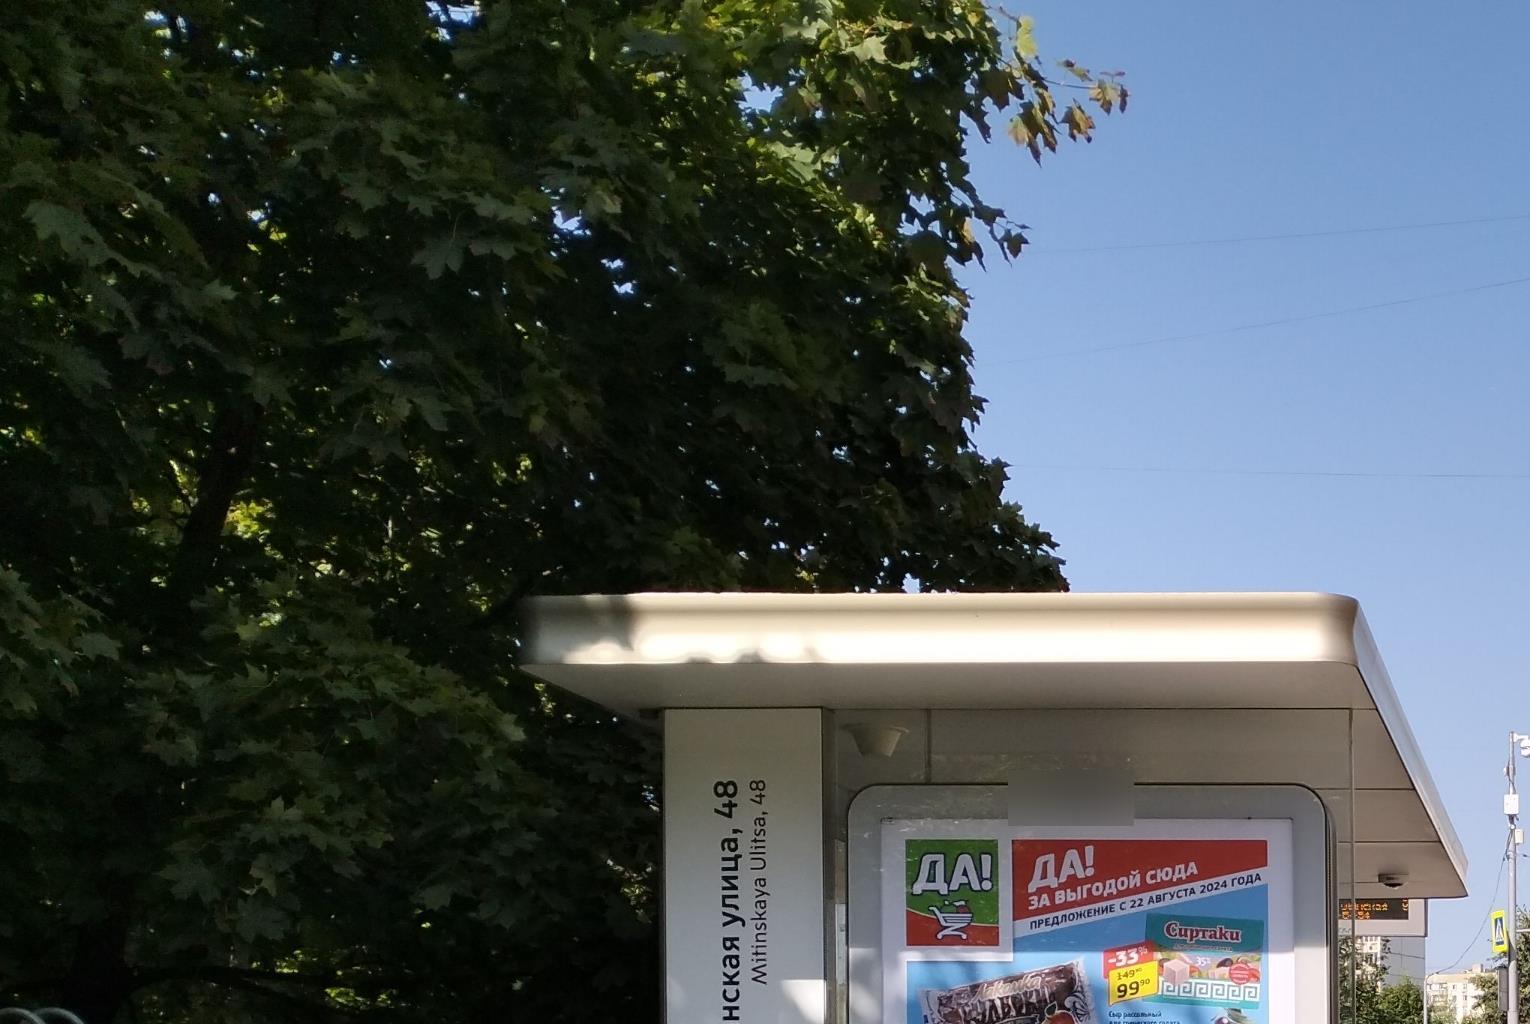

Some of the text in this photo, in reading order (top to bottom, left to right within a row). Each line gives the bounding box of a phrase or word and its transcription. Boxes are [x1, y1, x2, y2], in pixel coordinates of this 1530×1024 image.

[713, 779, 739, 818] 48
[720, 828, 746, 927] улица,
[750, 779, 770, 985] Mitinskaya Ulitsa, 48
[912, 853, 993, 895] ДА!
[1028, 846, 1095, 893] ДА!
[1028, 862, 1198, 910] ЗА ВЫГОДОЙ СЮДА
[1030, 872, 1263, 930] ПРЕДЛОЖЕНИЕ С 22 АВГУСТА 2024 ГОДА
[1107, 946, 1148, 968] -33%
